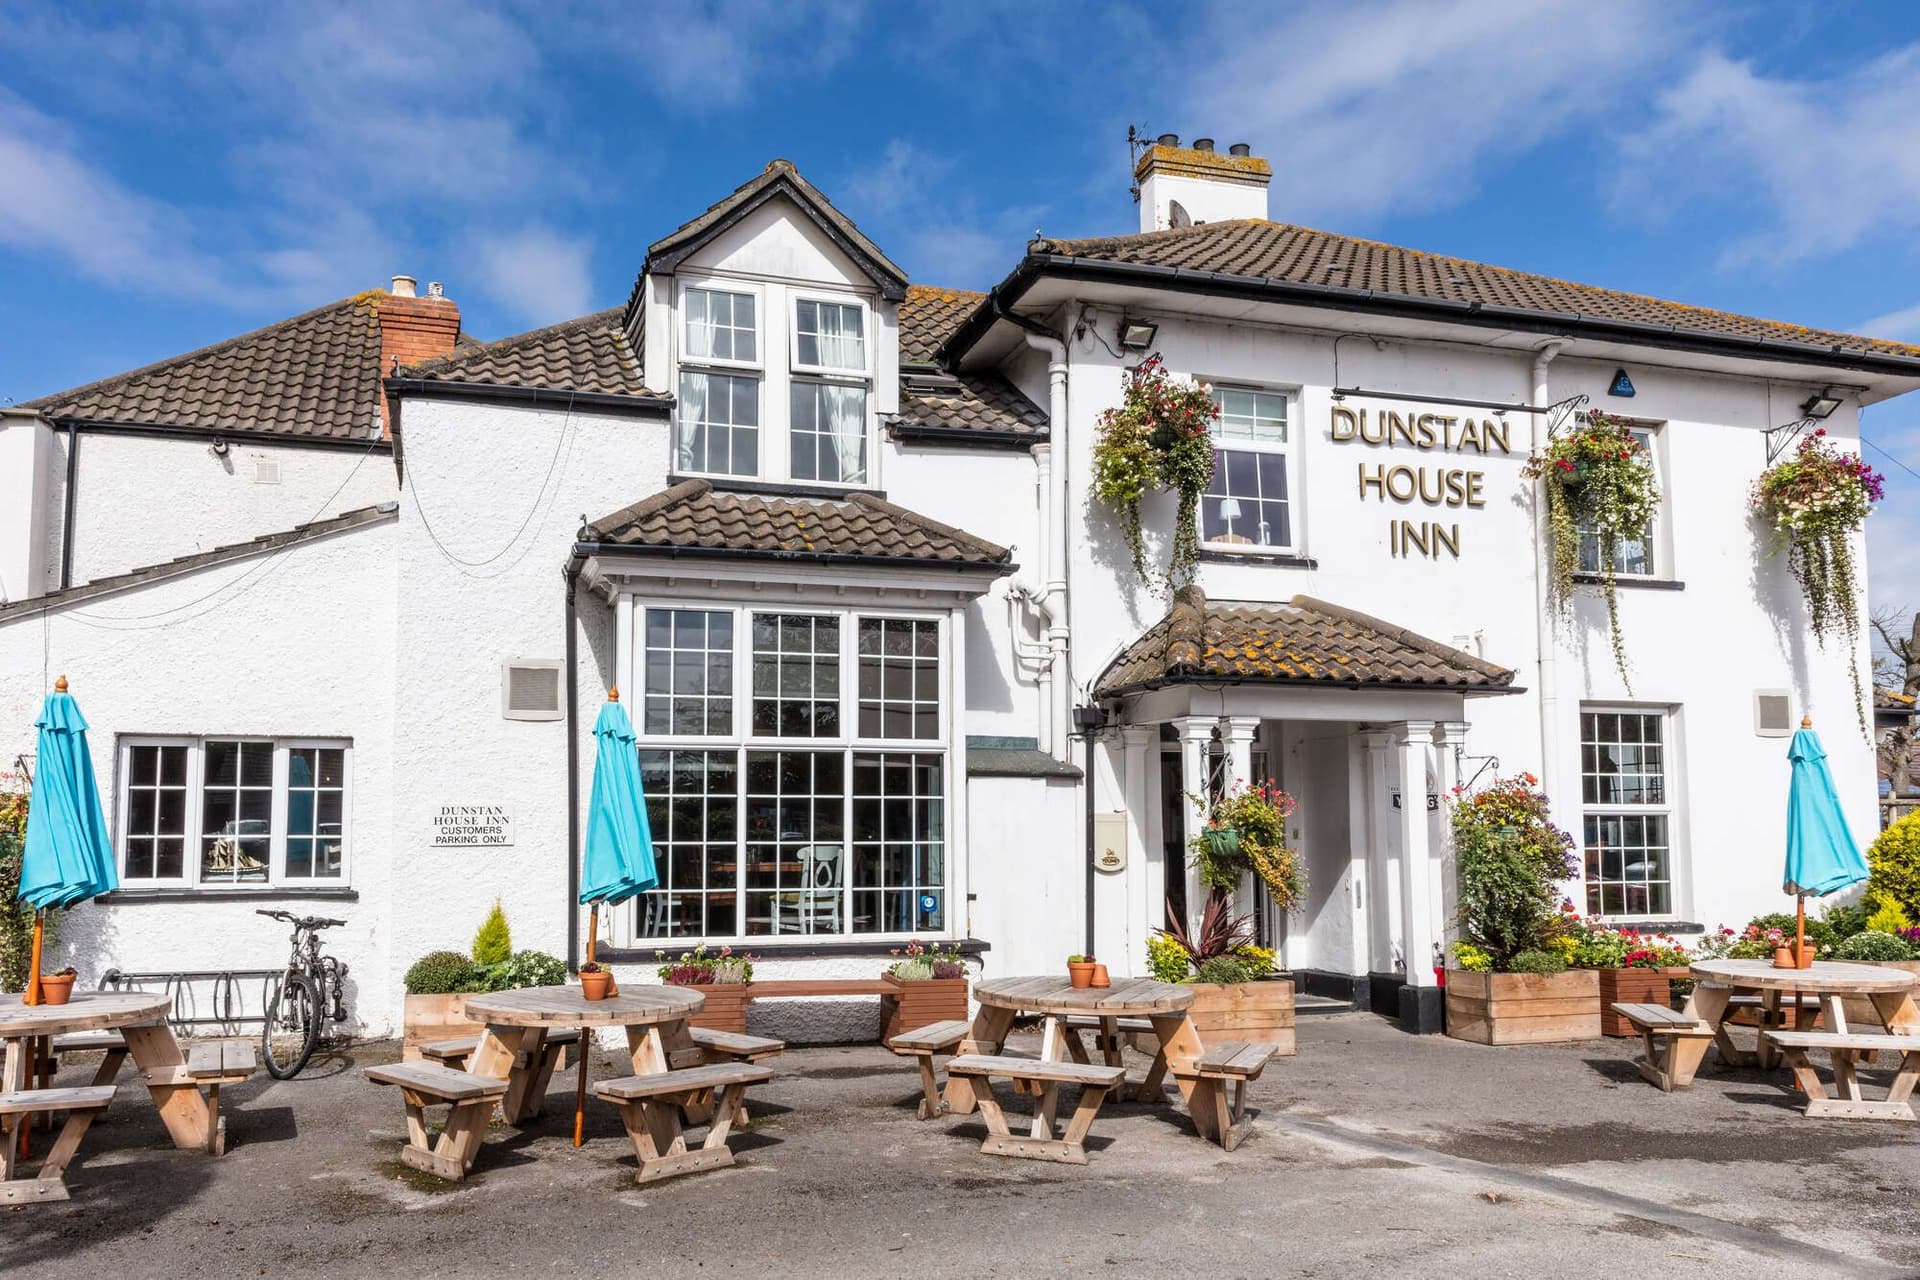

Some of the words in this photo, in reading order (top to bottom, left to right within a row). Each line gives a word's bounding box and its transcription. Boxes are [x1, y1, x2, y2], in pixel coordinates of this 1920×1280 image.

[1331, 405, 1510, 454] DUNSTAN
[1358, 462, 1487, 505] HOUSE
[1390, 519, 1460, 560] INN
[441, 806, 503, 815] DUNSTAN
[433, 816, 479, 826] HOUSE
[486, 816, 510, 825] INN
[441, 826, 502, 835] CUSTOMERS
[435, 836, 478, 844] PARKING
[482, 835, 507, 844] ONLY
